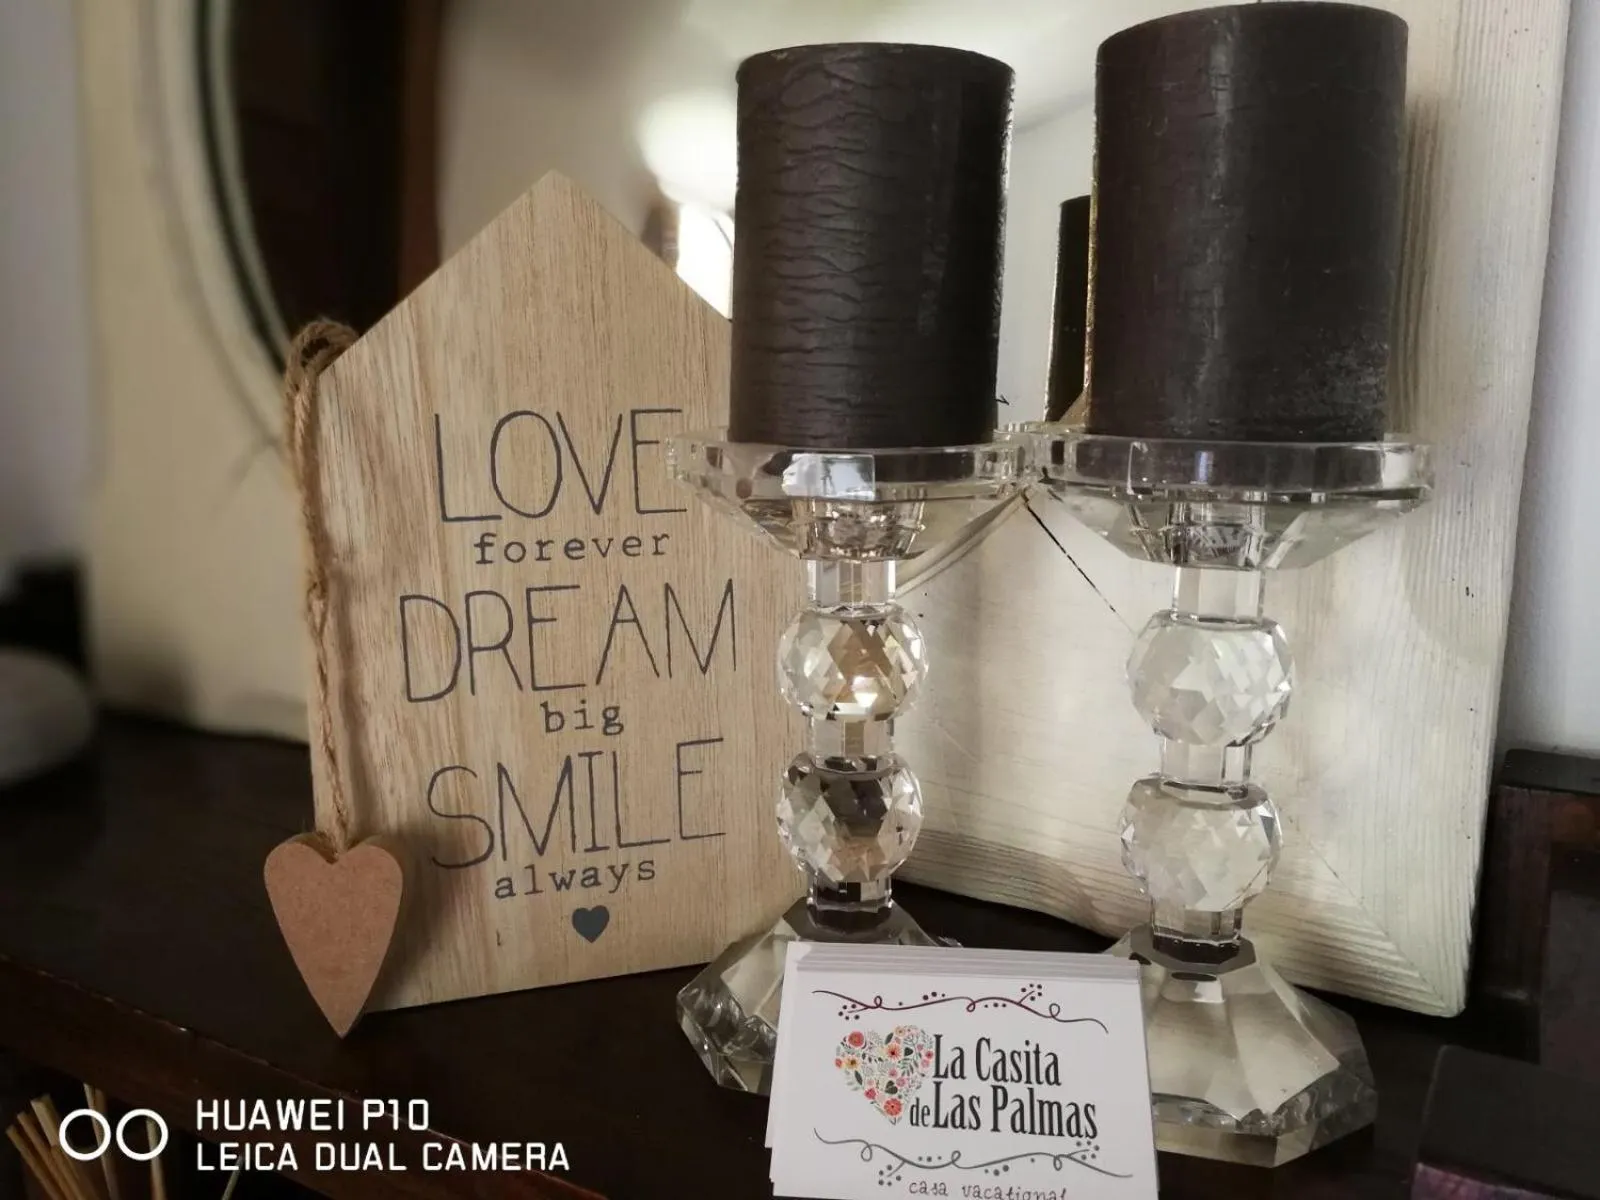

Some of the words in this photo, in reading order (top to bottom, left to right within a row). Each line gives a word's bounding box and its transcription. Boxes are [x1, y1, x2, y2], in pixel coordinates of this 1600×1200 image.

[435, 408, 687, 522] LOVE
[474, 530, 671, 564] forever
[400, 578, 737, 702] DREAM
[541, 699, 625, 735] big
[427, 737, 726, 870] SMILE
[494, 858, 656, 900] always
[932, 1034, 966, 1080] La
[975, 1036, 1062, 1086] Casita
[909, 1097, 931, 1128] de
[932, 1081, 981, 1131] Las
[990, 1085, 1098, 1139] Palmas
